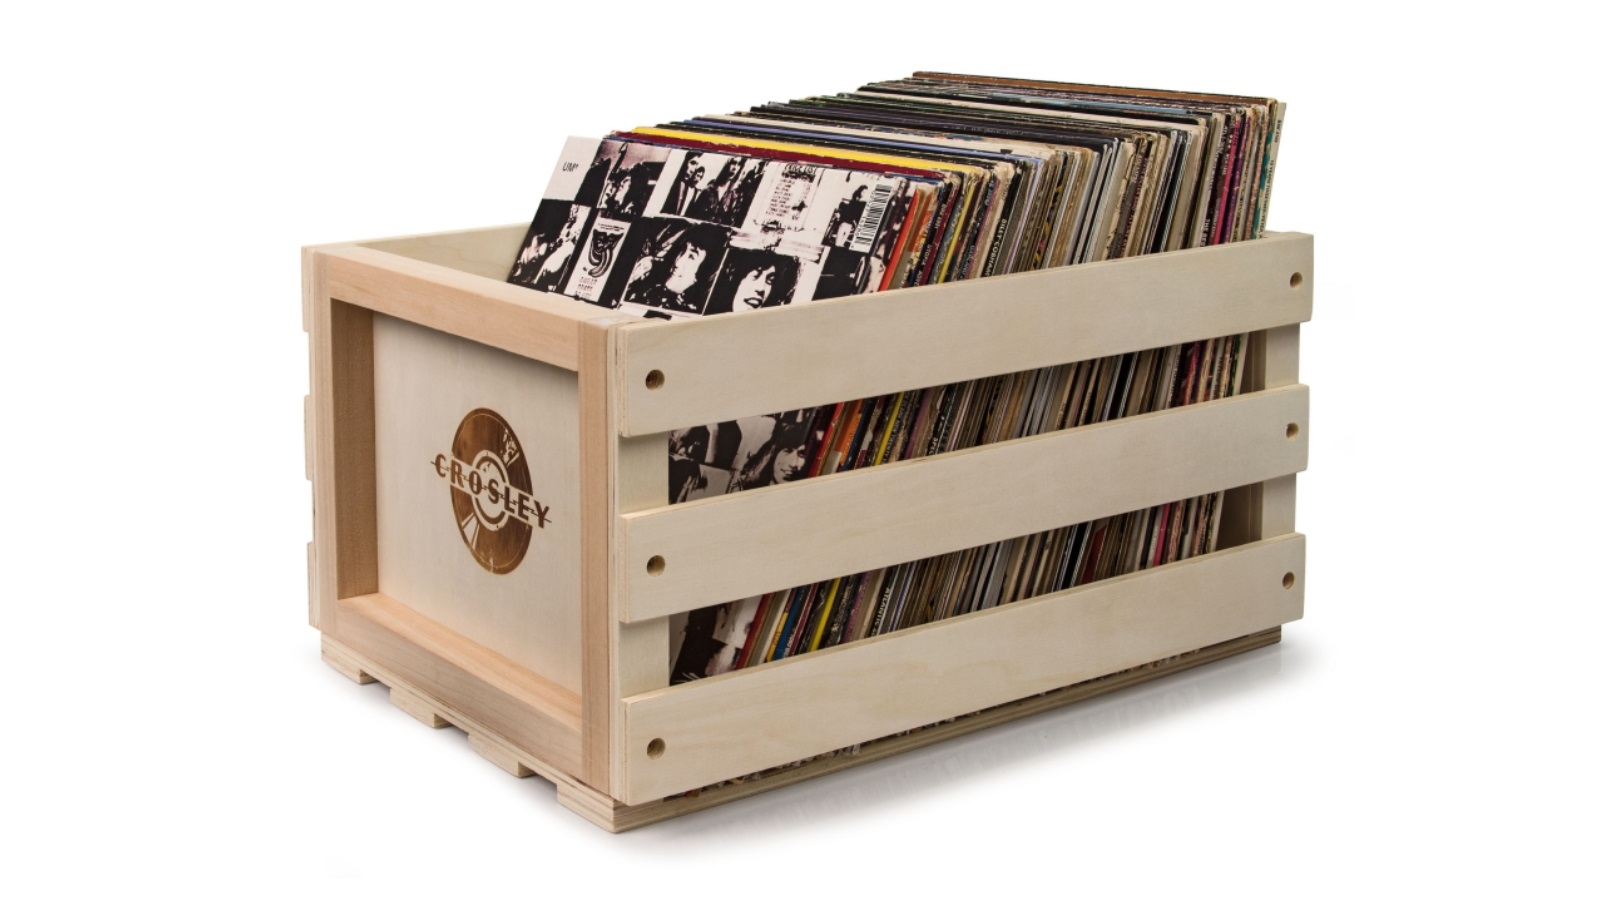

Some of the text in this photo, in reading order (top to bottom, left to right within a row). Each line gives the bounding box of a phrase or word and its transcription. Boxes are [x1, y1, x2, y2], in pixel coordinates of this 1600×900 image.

[997, 218, 1007, 238] BILLY
[432, 453, 551, 529] CROSLEY
[875, 588, 890, 626] ATLANTIC
